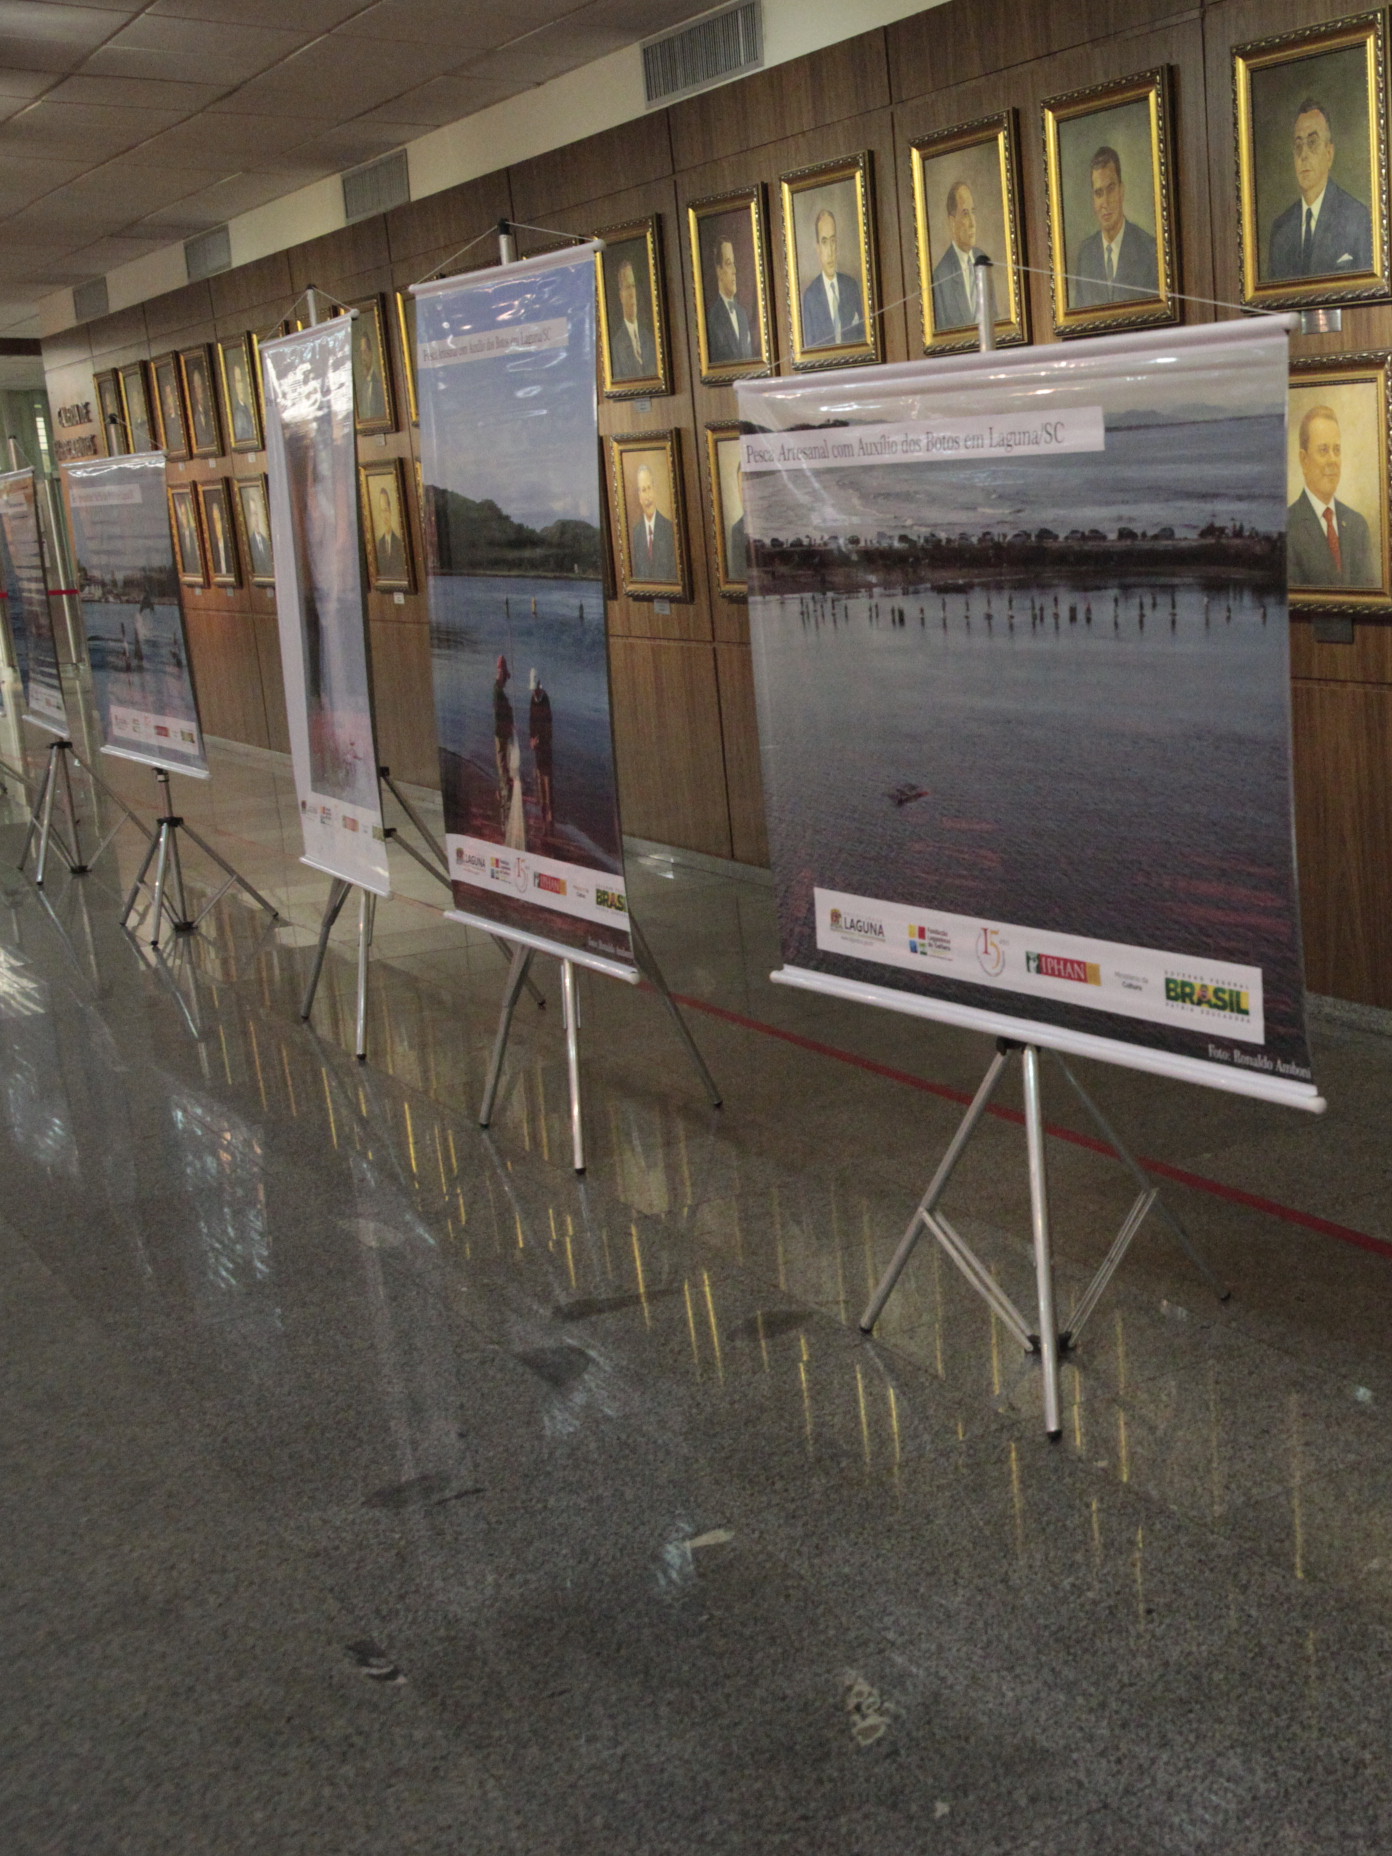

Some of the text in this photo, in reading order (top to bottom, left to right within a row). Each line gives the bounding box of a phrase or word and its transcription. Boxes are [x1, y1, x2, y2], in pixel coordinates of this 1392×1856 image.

[831, 444, 855, 459] com
[901, 432, 922, 454] dos
[925, 431, 961, 453] Botos
[963, 433, 985, 450] em
[844, 916, 885, 938] LAGUNA
[1041, 956, 1085, 980] IPHAN
[1165, 977, 1250, 1016] BRASIL
